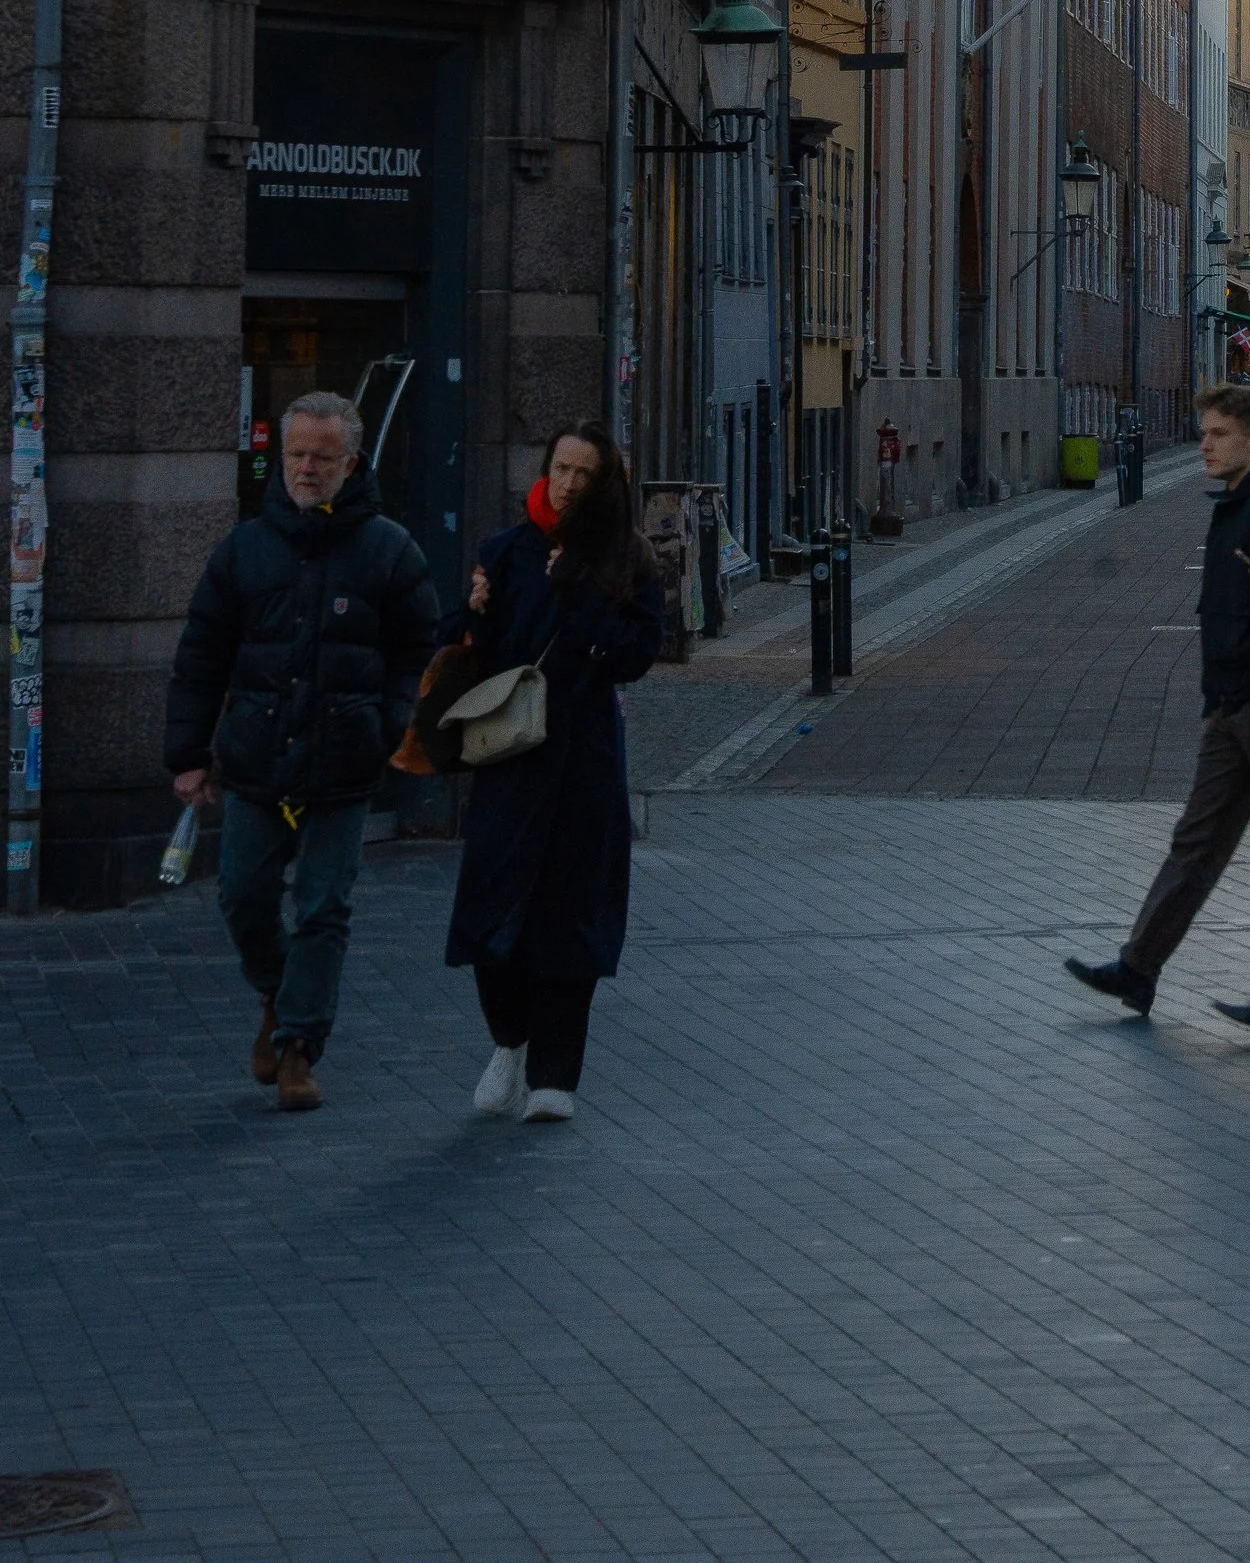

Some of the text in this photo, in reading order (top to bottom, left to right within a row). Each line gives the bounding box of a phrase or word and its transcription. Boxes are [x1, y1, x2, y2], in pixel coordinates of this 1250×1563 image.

[246, 141, 422, 177] ARNOLDBUSCK.DK
[259, 184, 409, 201] MERE MELLEM LINJERNE
